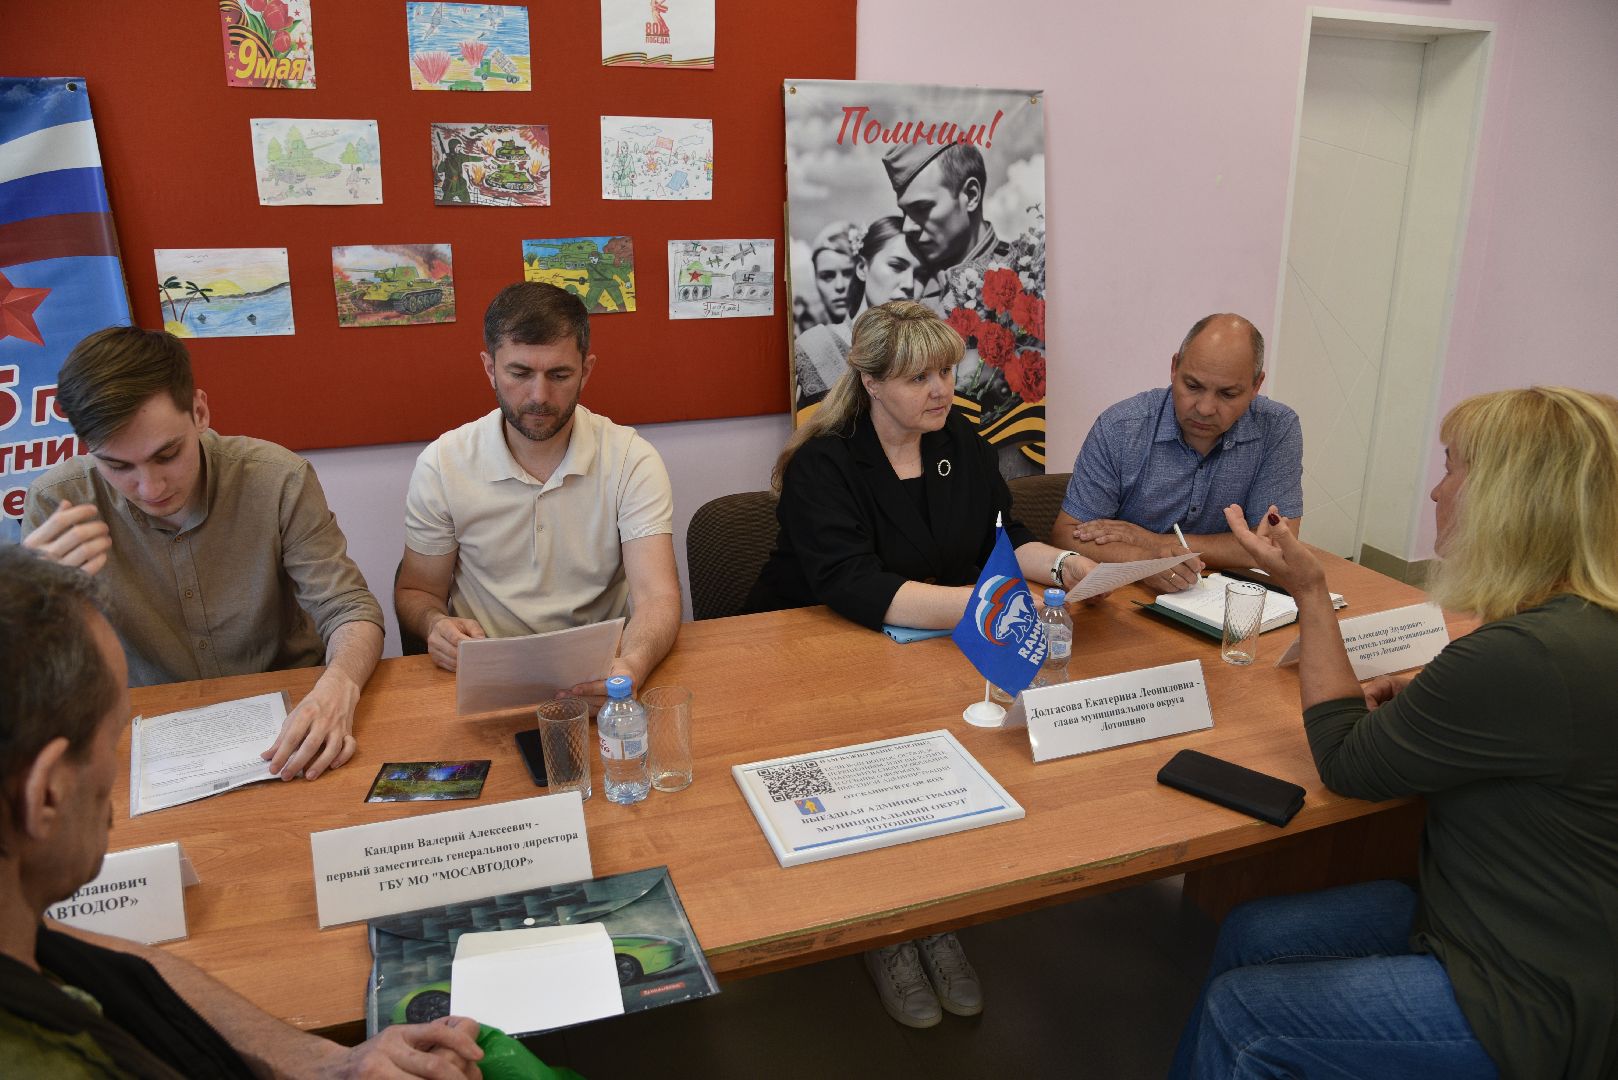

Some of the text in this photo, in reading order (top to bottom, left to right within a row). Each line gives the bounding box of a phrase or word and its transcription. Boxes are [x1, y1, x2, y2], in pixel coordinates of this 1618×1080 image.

[645, 36, 671, 44] ПОБЕДА!
[235, 39, 307, 80] 9 мая
[836, 106, 1004, 149] Помним!
[1030, 702, 1083, 720] Долгасова
[1084, 692, 1137, 709] Екатерина
[1139, 681, 1194, 699] Леонидовна
[1053, 696, 1185, 728] глава муниципального округа
[1101, 716, 1146, 731] Лотошино
[799, 787, 969, 824] ВЫЕЗДНАЯ АДМИНИСТРАЦИЯ
[815, 797, 969, 833] МУНИЦИПАЛЬНЫЙ ОКРУГ
[864, 813, 935, 831] ЛОТОШИНО
[326, 832, 578, 882] первый заместитель генерального директора
[364, 841, 415, 857] Кандрин
[417, 832, 466, 848] Валерий
[468, 822, 532, 840] Алексеевич
[379, 878, 404, 891] ГБУ
[408, 874, 429, 887] МО
